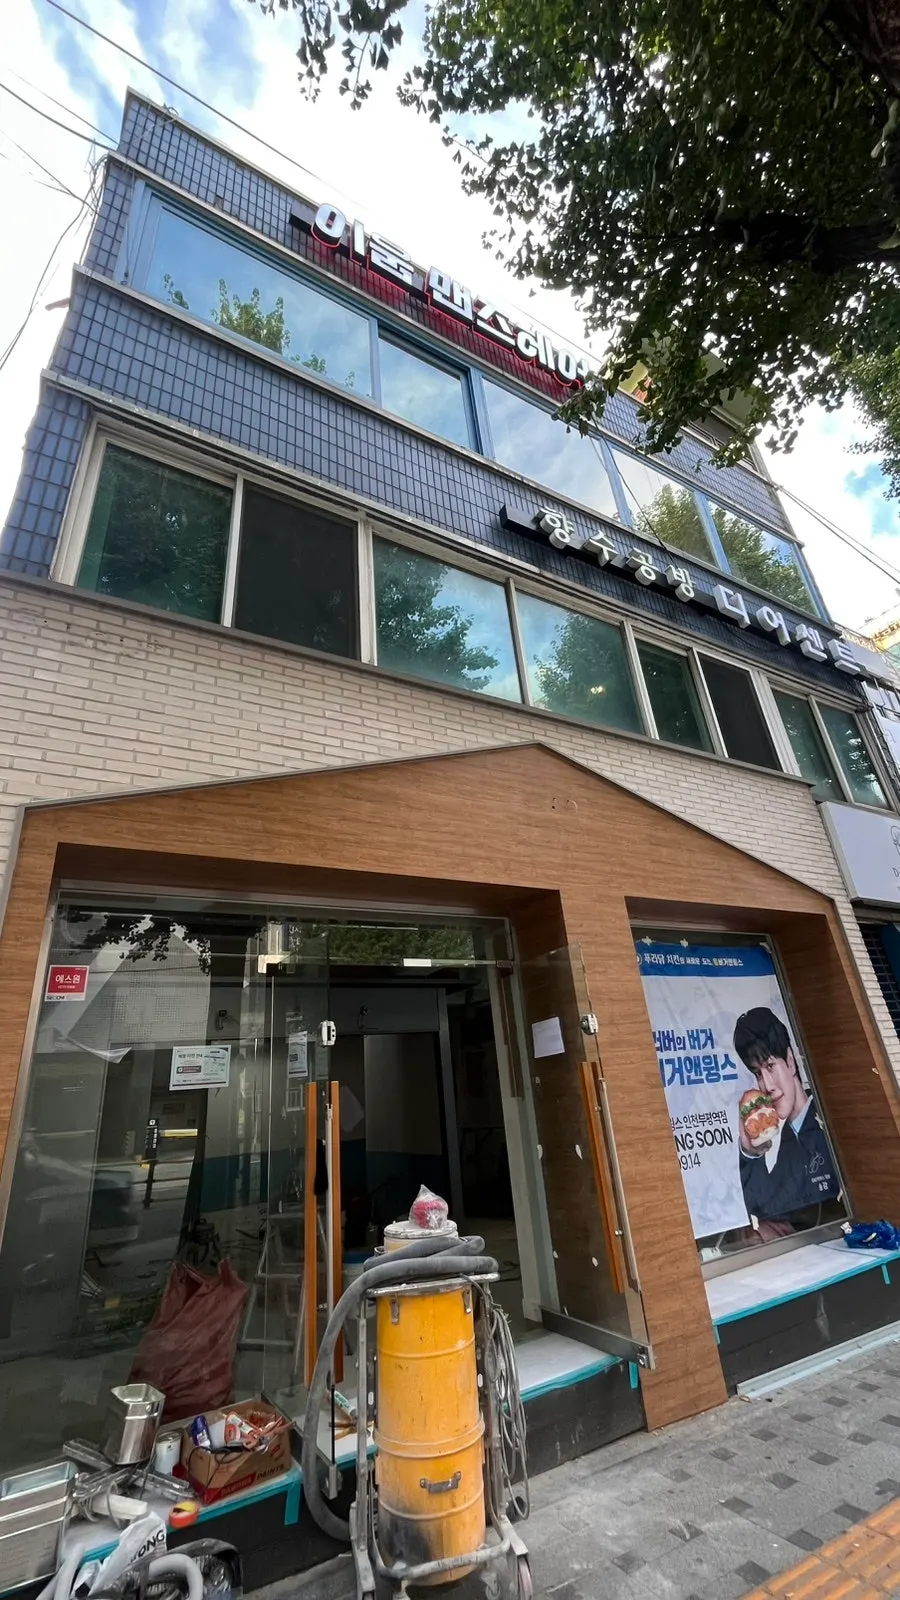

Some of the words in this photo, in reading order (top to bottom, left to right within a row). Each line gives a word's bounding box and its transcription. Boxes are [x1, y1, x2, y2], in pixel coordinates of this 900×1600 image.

[538, 506, 696, 602] 향수공방
[713, 584, 862, 675] 디어센트
[55, 974, 81, 984] 에스원
[687, 1028, 715, 1050] 버거
[695, 1126, 734, 1148] SOON
[679, 1152, 701, 1171] 9.14
